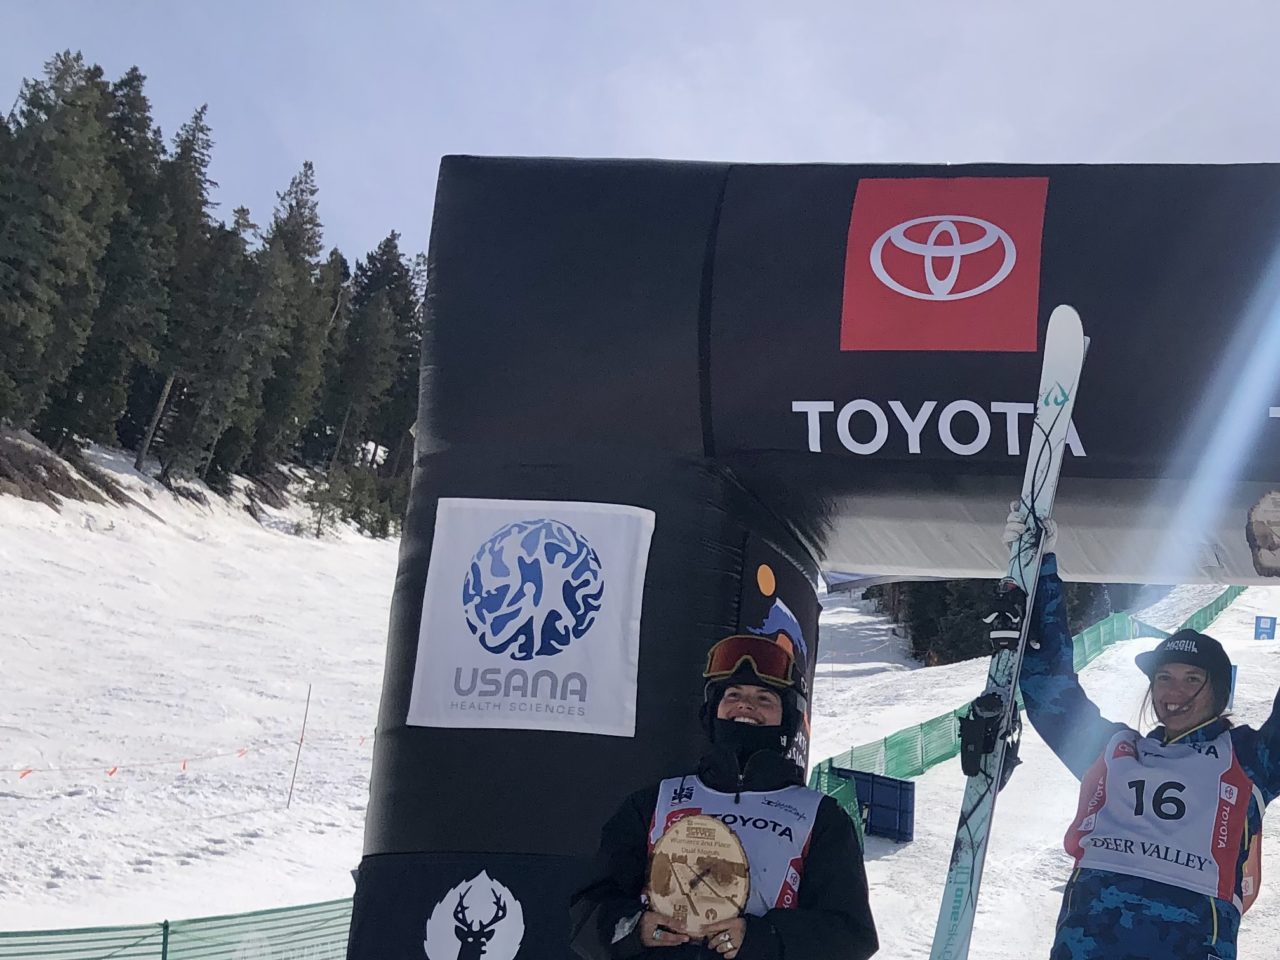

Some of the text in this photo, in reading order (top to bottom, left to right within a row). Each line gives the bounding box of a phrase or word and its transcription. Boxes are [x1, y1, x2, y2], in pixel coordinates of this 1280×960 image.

[453, 667, 587, 702] USANA
[450, 701, 586, 716] HEALTH SCIENCES
[1127, 779, 1187, 821] 16
[1217, 806, 1231, 849] TOYOTA
[1090, 838, 1208, 871] DEER VALLEY
